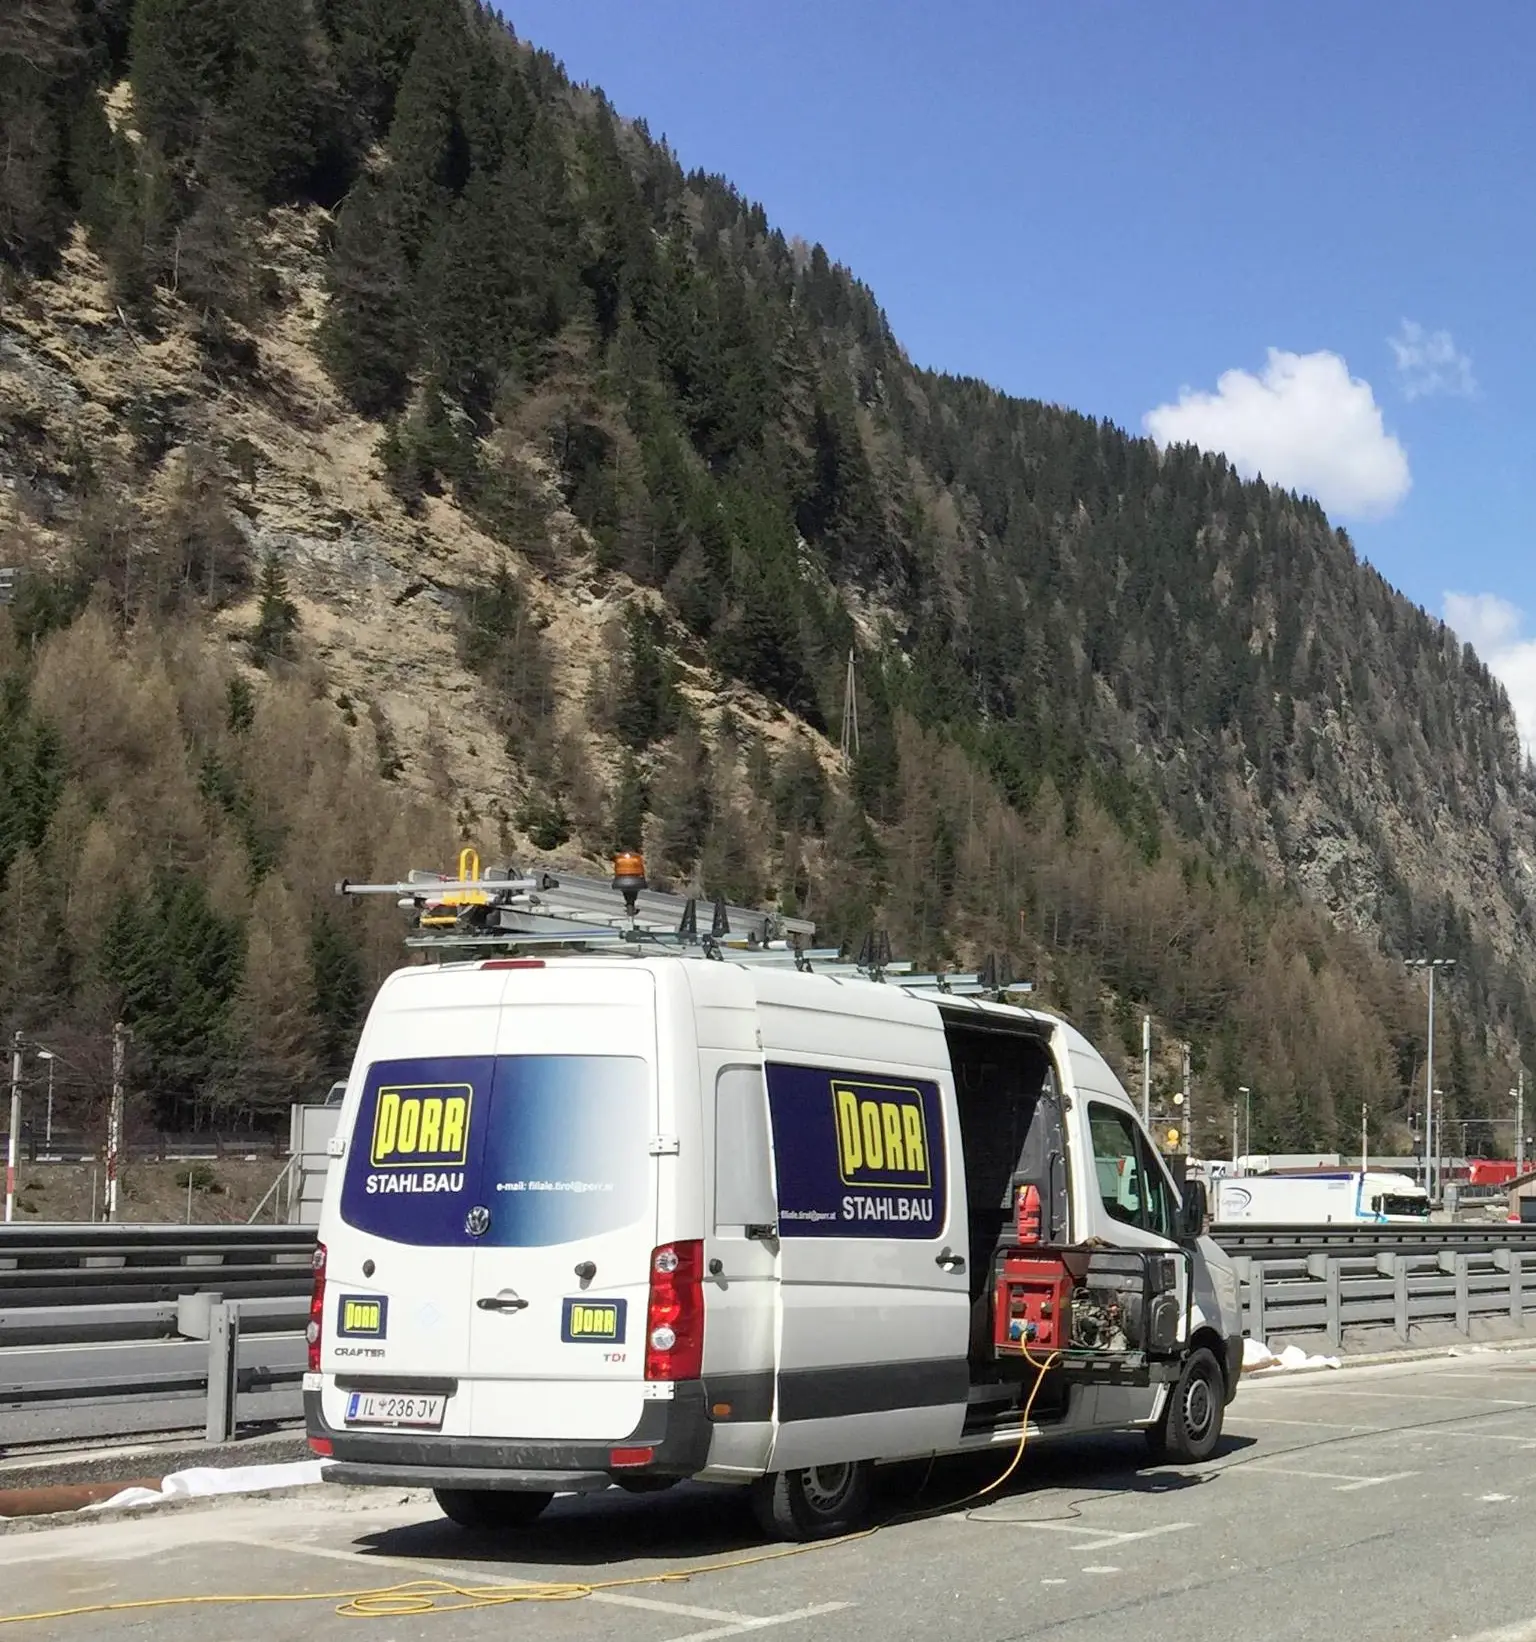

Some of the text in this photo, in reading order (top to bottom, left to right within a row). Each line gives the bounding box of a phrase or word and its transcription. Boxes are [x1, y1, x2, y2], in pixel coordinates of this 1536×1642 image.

[375, 1093, 466, 1160] PORR
[837, 1090, 925, 1175] PORR
[366, 1172, 464, 1194] STAHLBAU
[496, 1181, 527, 1191] e-mail:
[842, 1196, 933, 1221] STAHLBAU
[346, 1302, 379, 1330] PORR
[573, 1306, 615, 1335] PORR
[334, 1347, 386, 1358] CRAFTER
[604, 1353, 627, 1363] TDI
[387, 1400, 415, 1418] 236
[417, 1400, 437, 1418] JV
